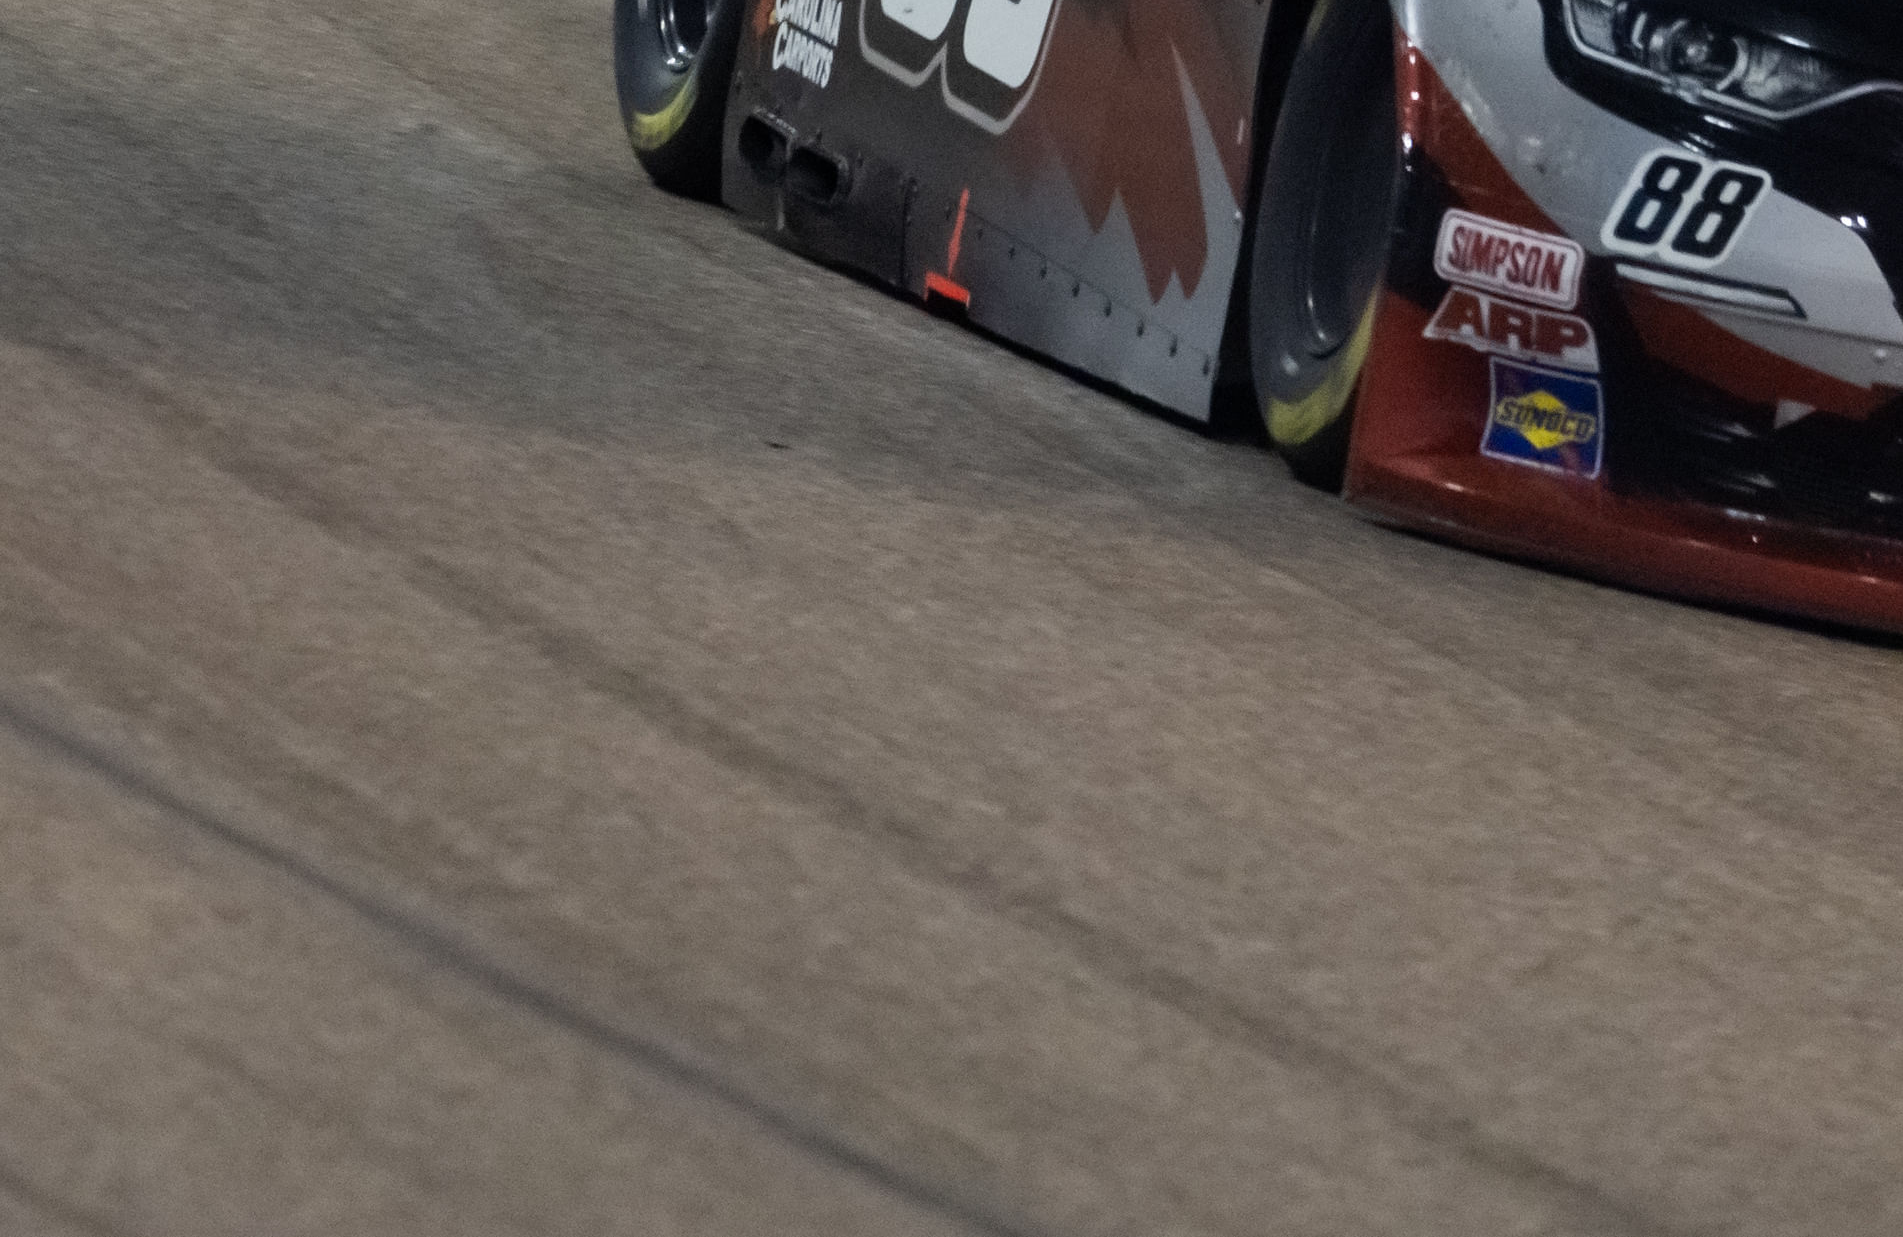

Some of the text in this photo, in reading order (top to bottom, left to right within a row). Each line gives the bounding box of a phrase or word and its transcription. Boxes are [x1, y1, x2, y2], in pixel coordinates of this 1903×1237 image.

[772, 21, 834, 88] CARPORTS
[1611, 155, 1766, 258] 88
[1448, 226, 1567, 293] SIMPSON
[1435, 290, 1588, 356] ARP
[1498, 398, 1593, 438] SUNOCO
